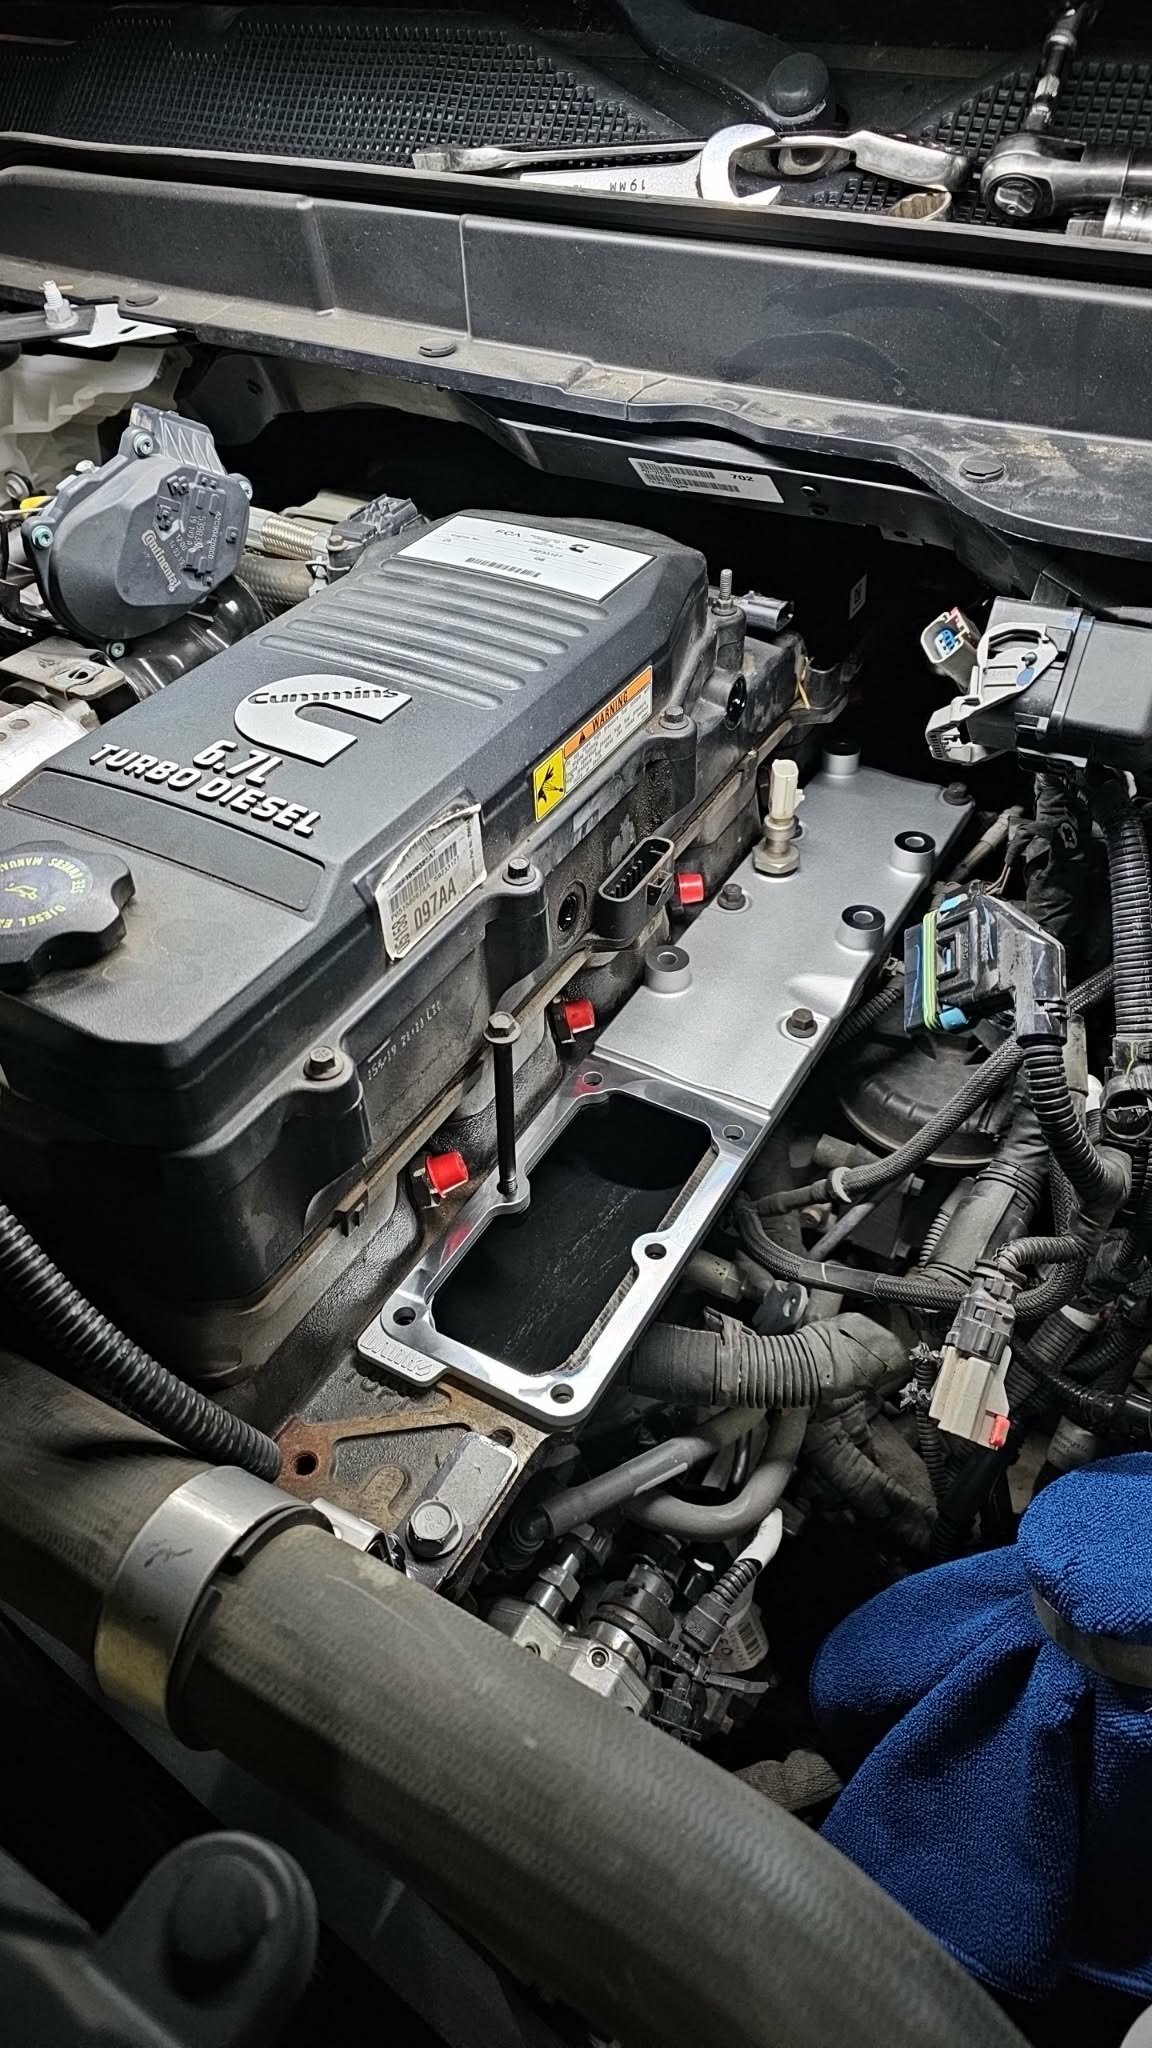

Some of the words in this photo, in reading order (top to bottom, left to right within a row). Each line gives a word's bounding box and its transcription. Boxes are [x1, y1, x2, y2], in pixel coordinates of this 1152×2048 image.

[730, 473, 755, 482] 702
[495, 529, 521, 538] FCA
[142, 529, 181, 592] Continental
[248, 686, 399, 705] Cummins
[592, 690, 629, 733] WARNING
[192, 739, 283, 788] 6.7L
[89, 743, 201, 791] TURBO
[195, 776, 321, 838] DIESEL
[0, 856, 44, 872] MANUA
[70, 879, 86, 894] SEE
[19, 904, 67, 927] DIESEL
[414, 877, 457, 931] 097AA
